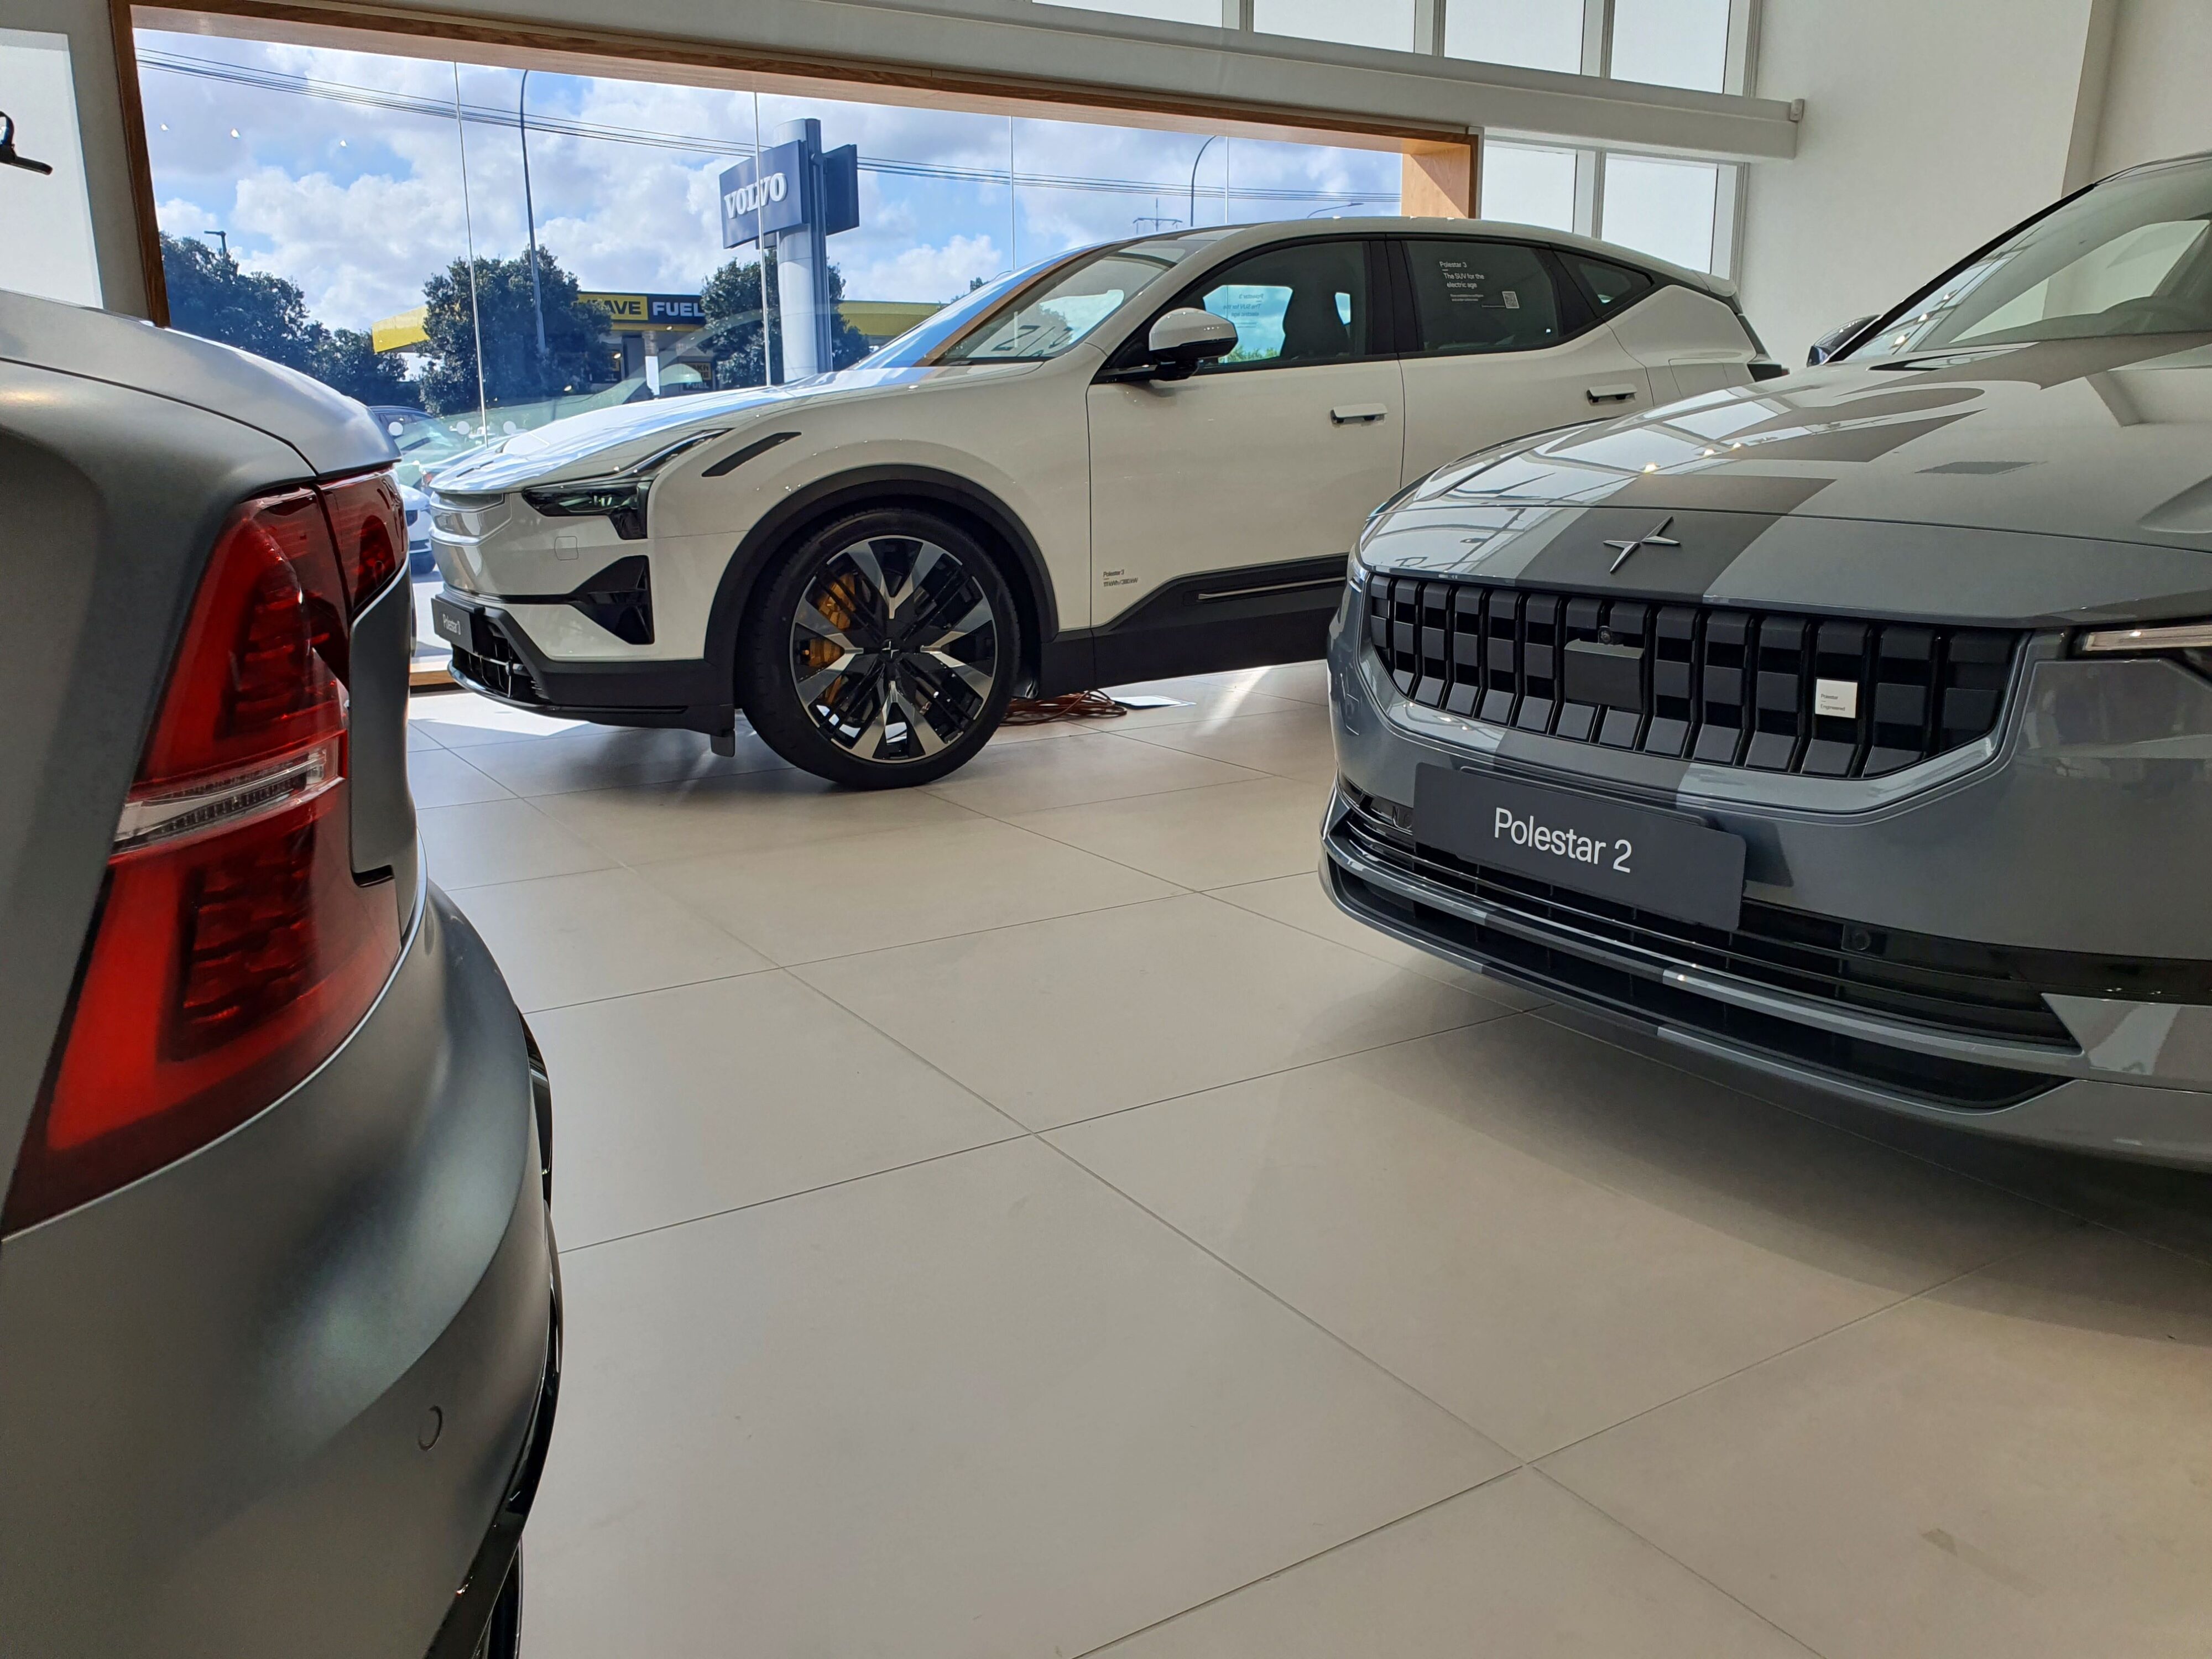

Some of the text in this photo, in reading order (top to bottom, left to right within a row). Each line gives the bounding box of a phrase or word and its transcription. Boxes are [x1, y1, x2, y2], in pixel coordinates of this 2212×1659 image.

[724, 172, 787, 219] VOLVO
[653, 301, 706, 317] FUEL
[1494, 807, 1632, 873] Polestar 2
